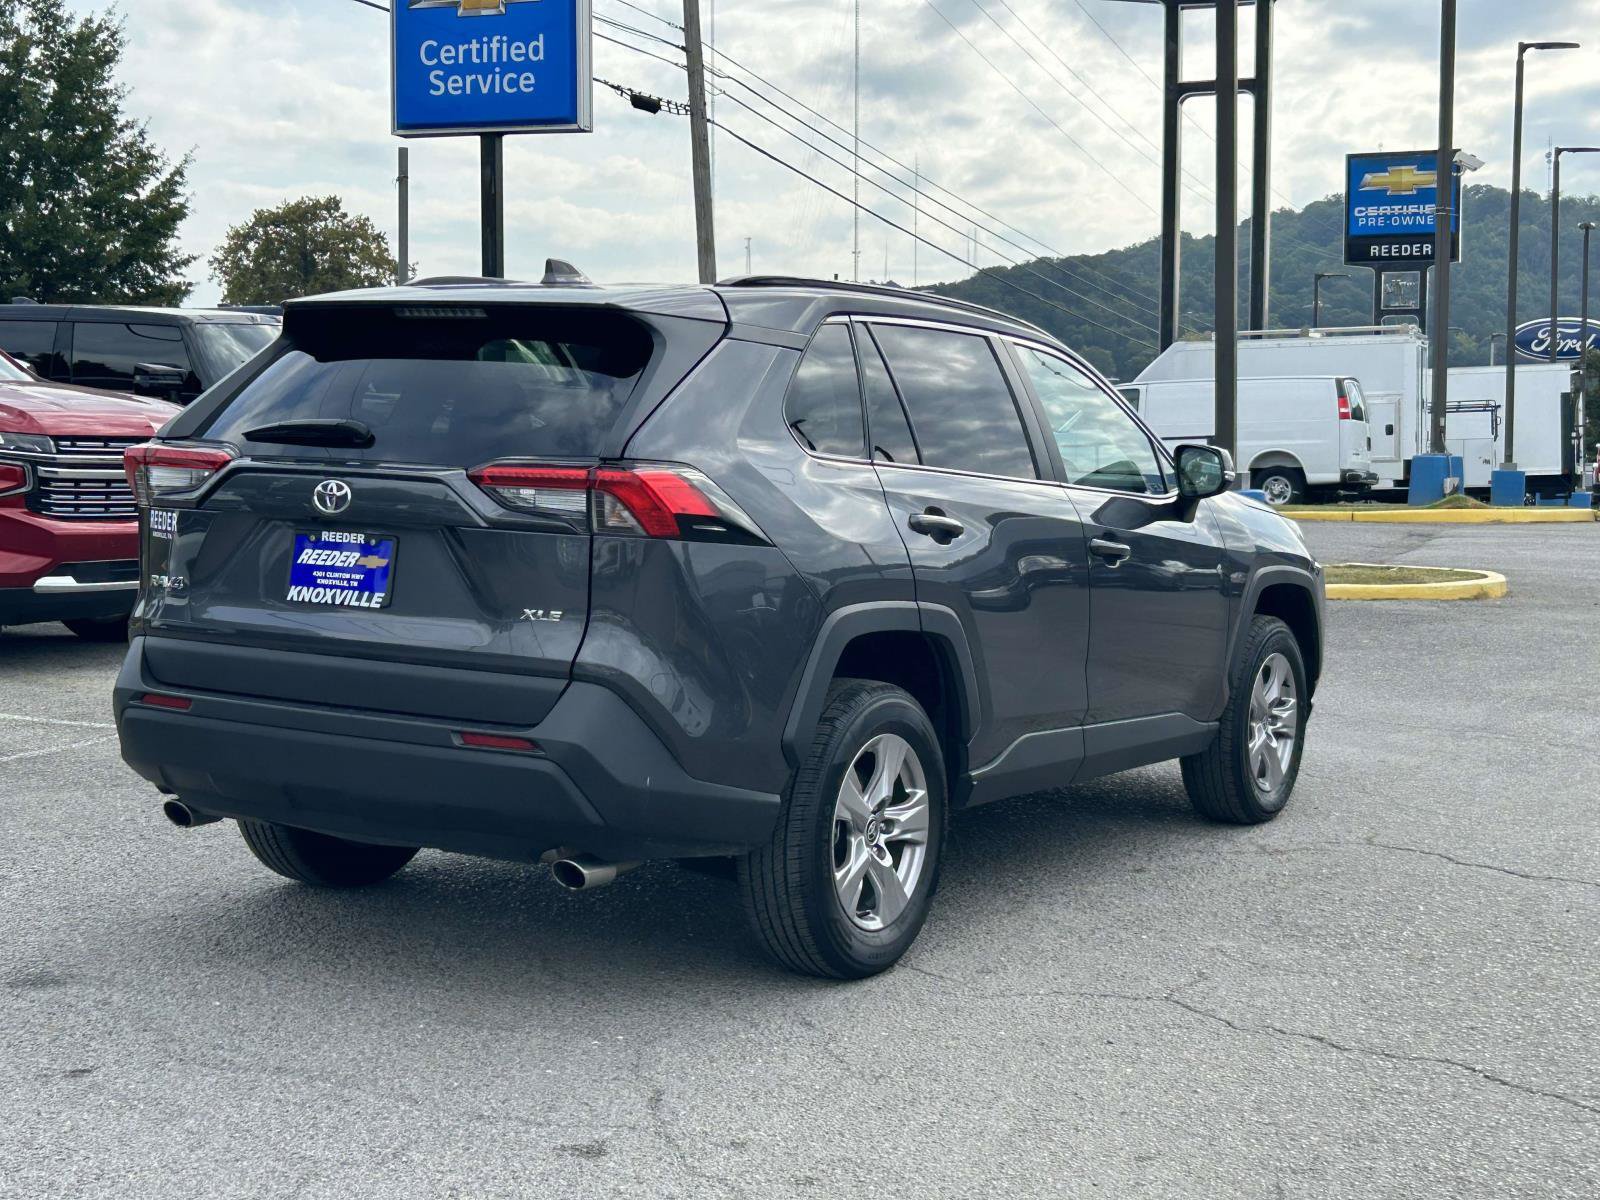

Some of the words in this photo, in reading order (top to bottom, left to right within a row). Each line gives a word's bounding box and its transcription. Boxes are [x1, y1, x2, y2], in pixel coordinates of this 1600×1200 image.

[419, 33, 545, 66] Certified
[429, 66, 536, 96] Service
[1354, 204, 1436, 217] CERTIFIE
[1358, 215, 1434, 227] PRE-OWNE
[1370, 244, 1432, 257] REEDER
[150, 509, 177, 532] REEDER
[321, 531, 365, 544] REEDER
[296, 548, 361, 567] REEDER
[286, 585, 385, 608] KNOXVILLE
[520, 608, 563, 622] XLE
